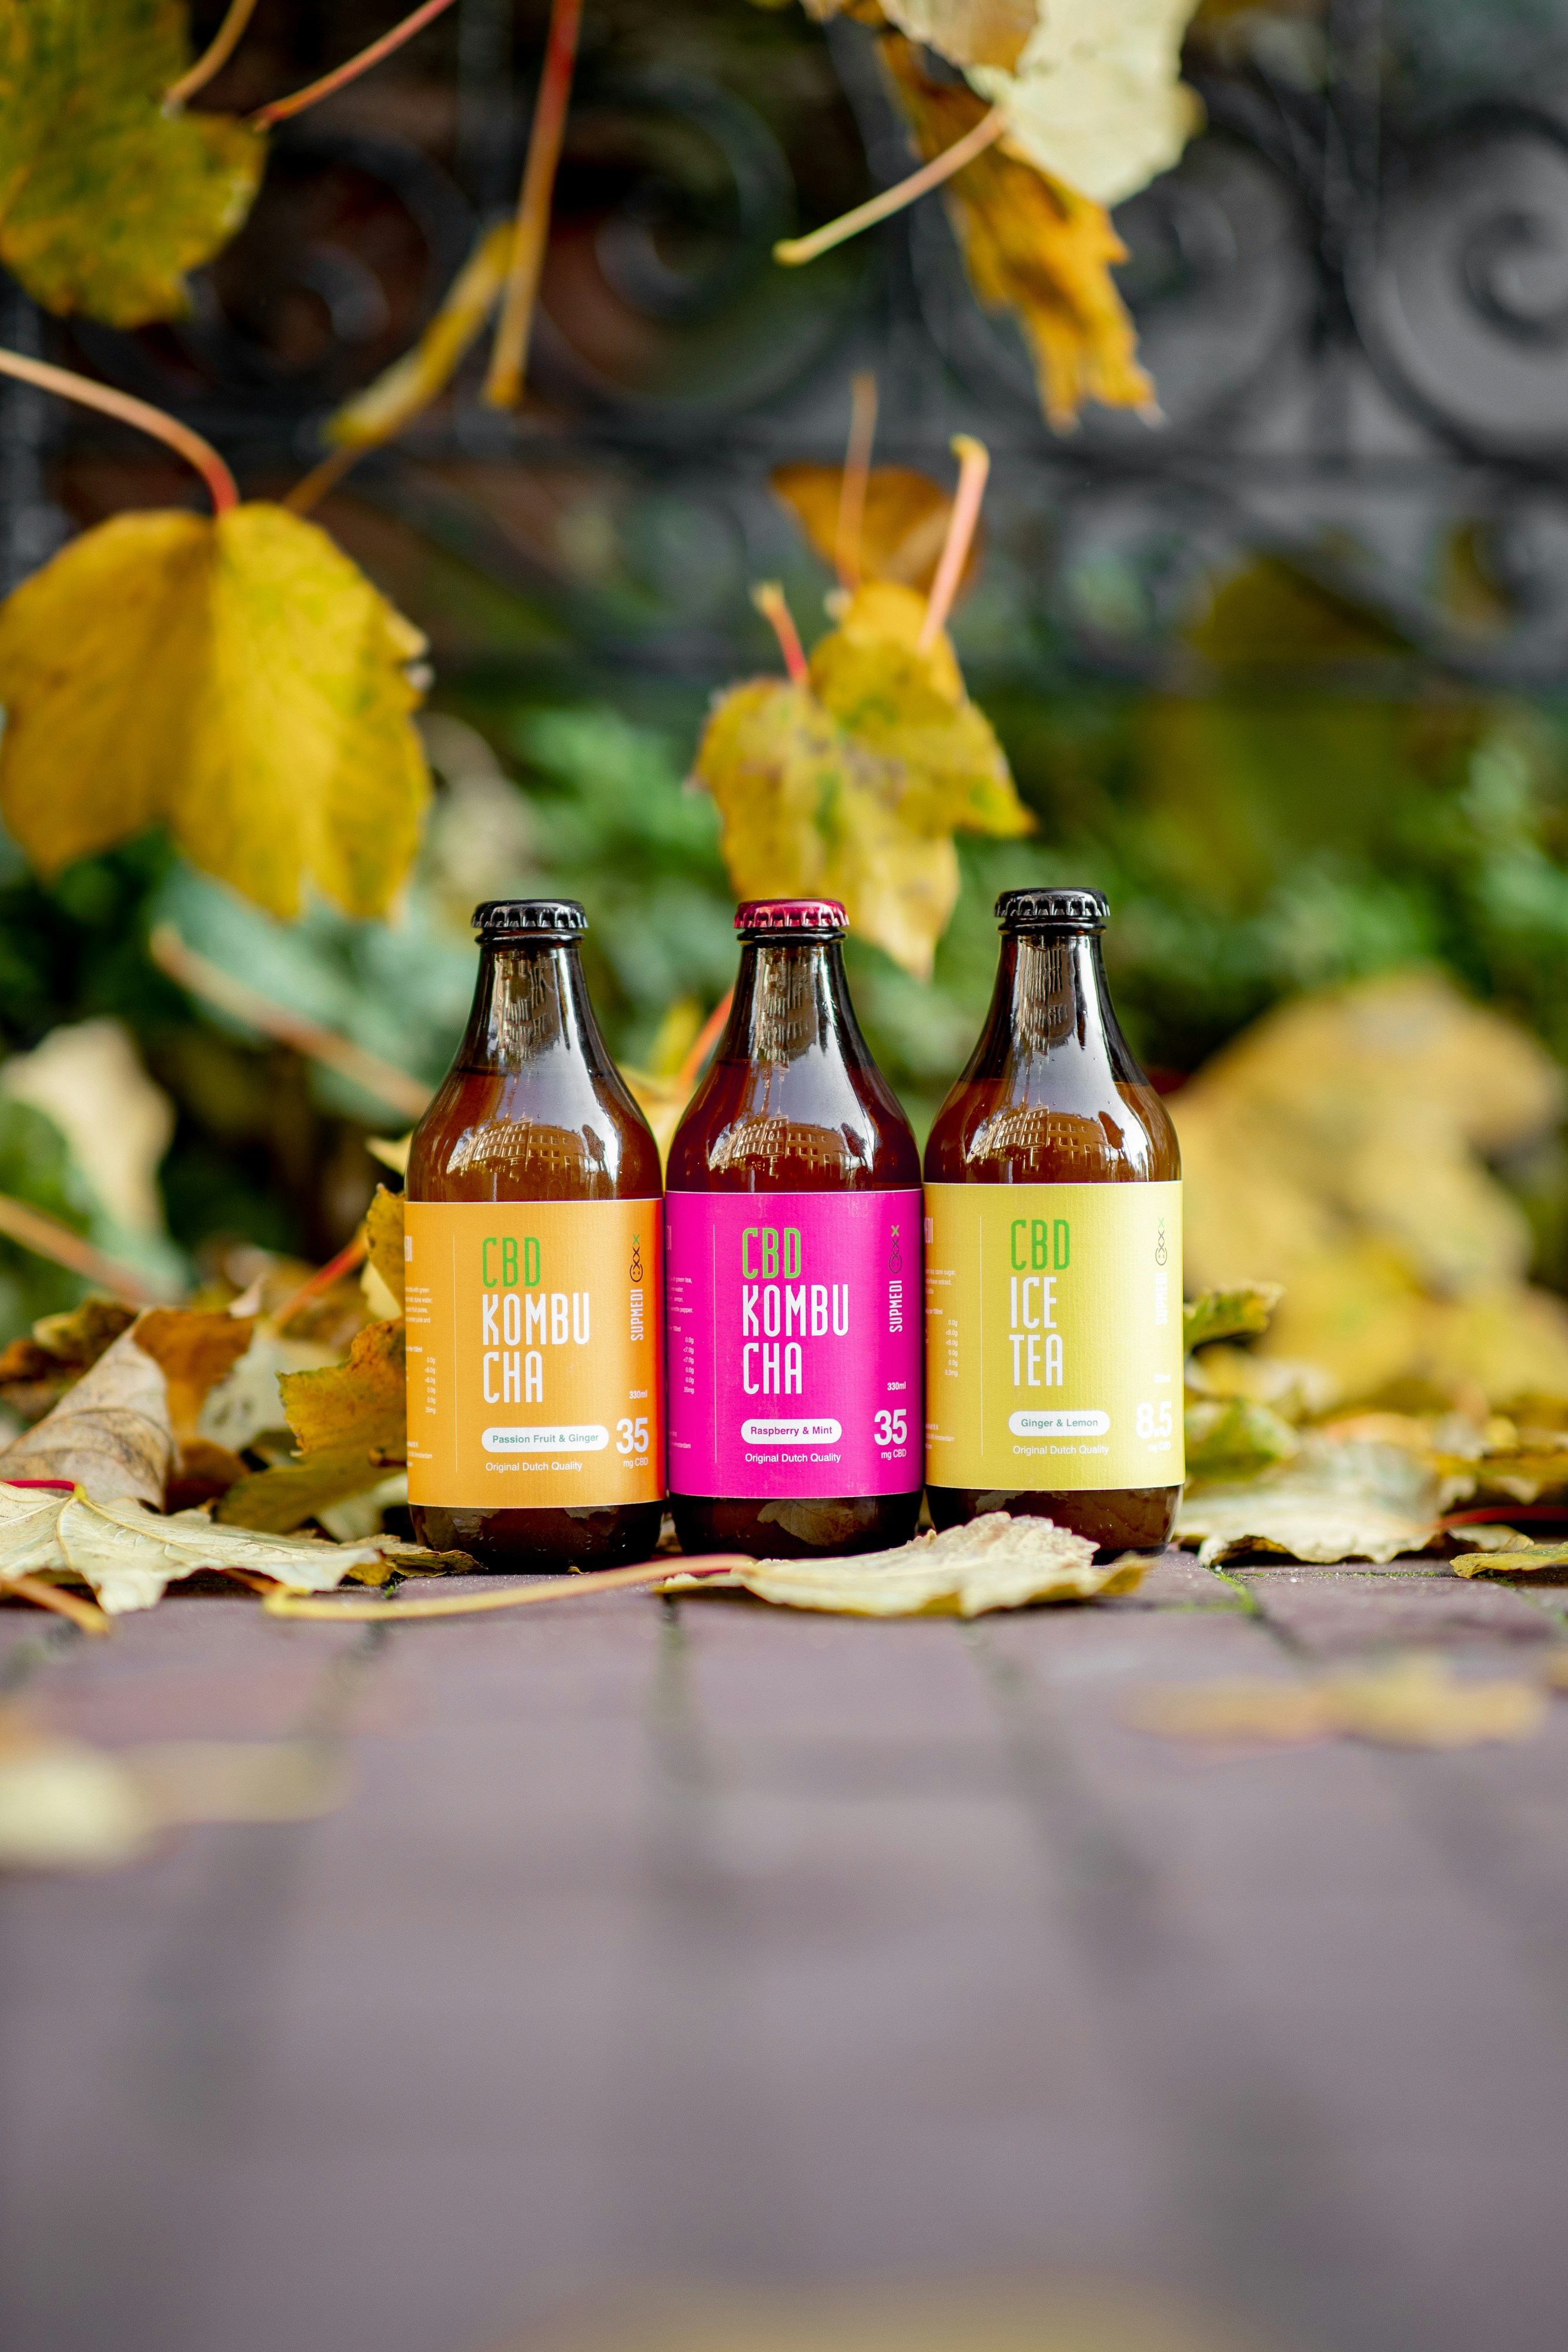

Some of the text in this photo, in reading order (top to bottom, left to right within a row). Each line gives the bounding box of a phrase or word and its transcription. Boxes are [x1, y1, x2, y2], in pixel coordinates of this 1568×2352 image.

[483, 1237, 540, 1288] CBD
[743, 1228, 801, 1279] CBD
[1011, 1219, 1070, 1270] CBD
[483, 1292, 590, 1346] KOMBU
[630, 1289, 643, 1341] SUPMEDI
[743, 1284, 849, 1337] KOMBU
[890, 1281, 902, 1332] SUPMEDI
[1011, 1276, 1057, 1329] ICE
[483, 1350, 543, 1403] CHA
[743, 1342, 802, 1394] CHA
[1009, 1334, 1063, 1386] TEA
[628, 1390, 647, 1399] 330ml
[887, 1382, 906, 1391] 330ml
[569, 1434, 599, 1443] Ginger
[616, 1417, 648, 1454] 35
[751, 1427, 799, 1436] Raspberry
[874, 1409, 907, 1445] 35
[1021, 1419, 1053, 1429] Ginger
[1136, 1401, 1172, 1439] 8.5
[486, 1461, 583, 1473] Original Dutch Quality
[623, 1457, 648, 1468] mg CBD
[745, 1453, 841, 1464] Original Dutch Quality
[881, 1449, 906, 1460] mg CBD
[1012, 1444, 1110, 1456] Original Dutch Quality
